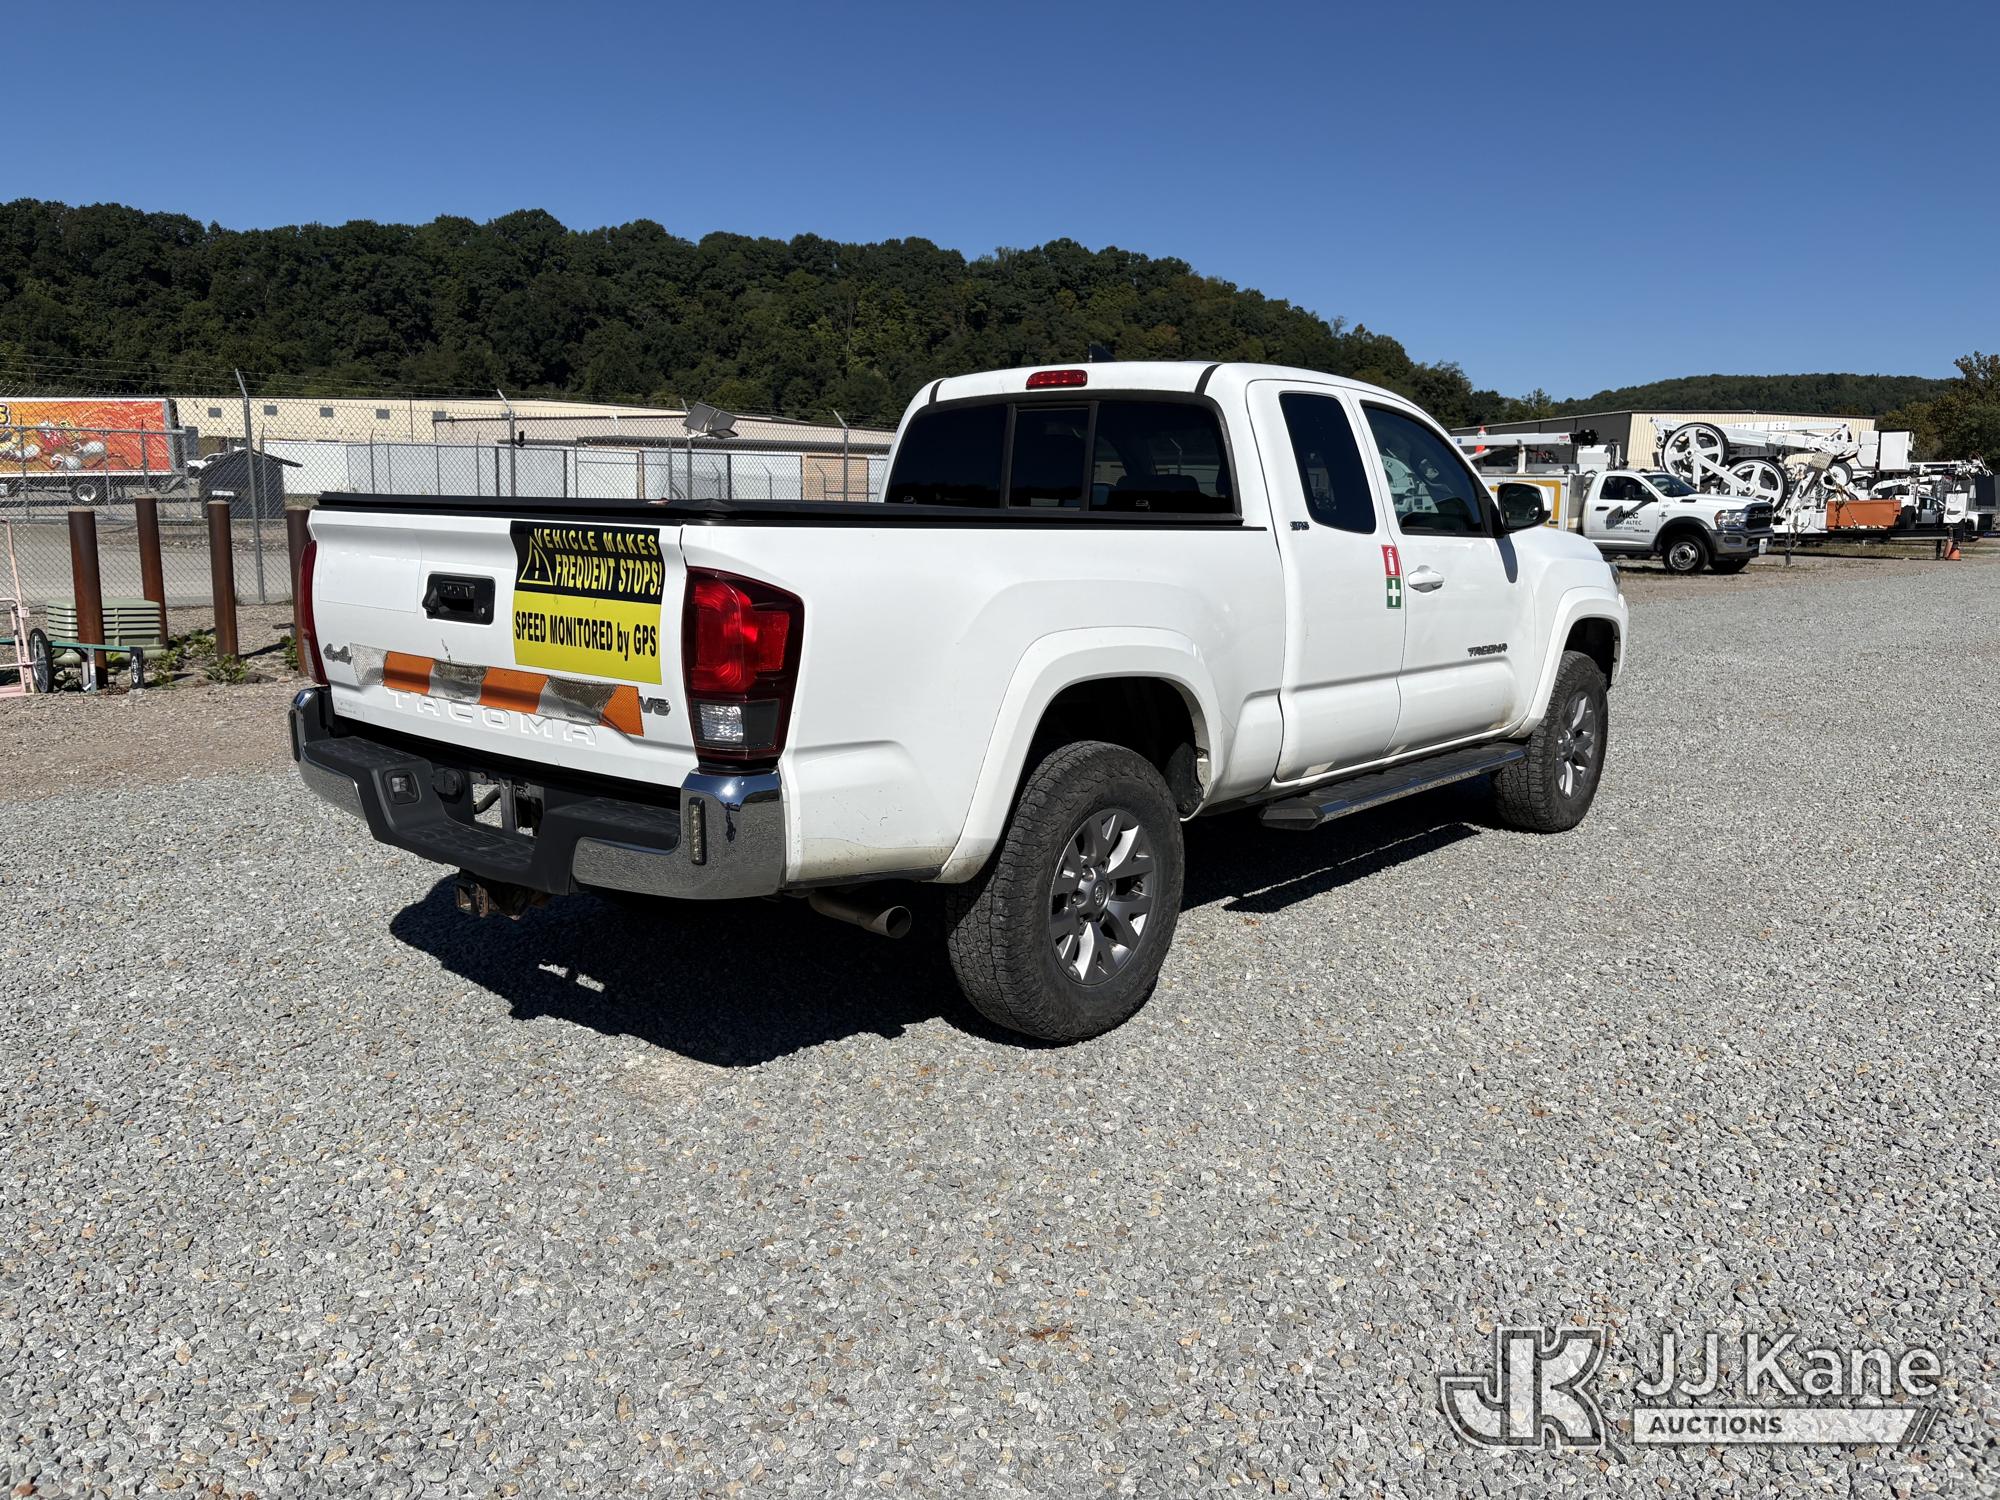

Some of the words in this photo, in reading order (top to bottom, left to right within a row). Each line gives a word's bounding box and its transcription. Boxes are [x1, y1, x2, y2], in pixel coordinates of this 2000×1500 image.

[534, 528, 598, 552] VEHICLE
[602, 532, 658, 556] MAKES
[553, 554, 616, 591] FREQUENT
[618, 558, 663, 596] STOPS!
[515, 610, 547, 643] SPEED
[549, 614, 613, 651] MONITORED
[617, 622, 630, 661] by
[633, 623, 657, 657] GPS
[1467, 643, 1508, 657] TACOMA
[386, 687, 597, 747] TACOMA
[639, 696, 671, 716] V6
